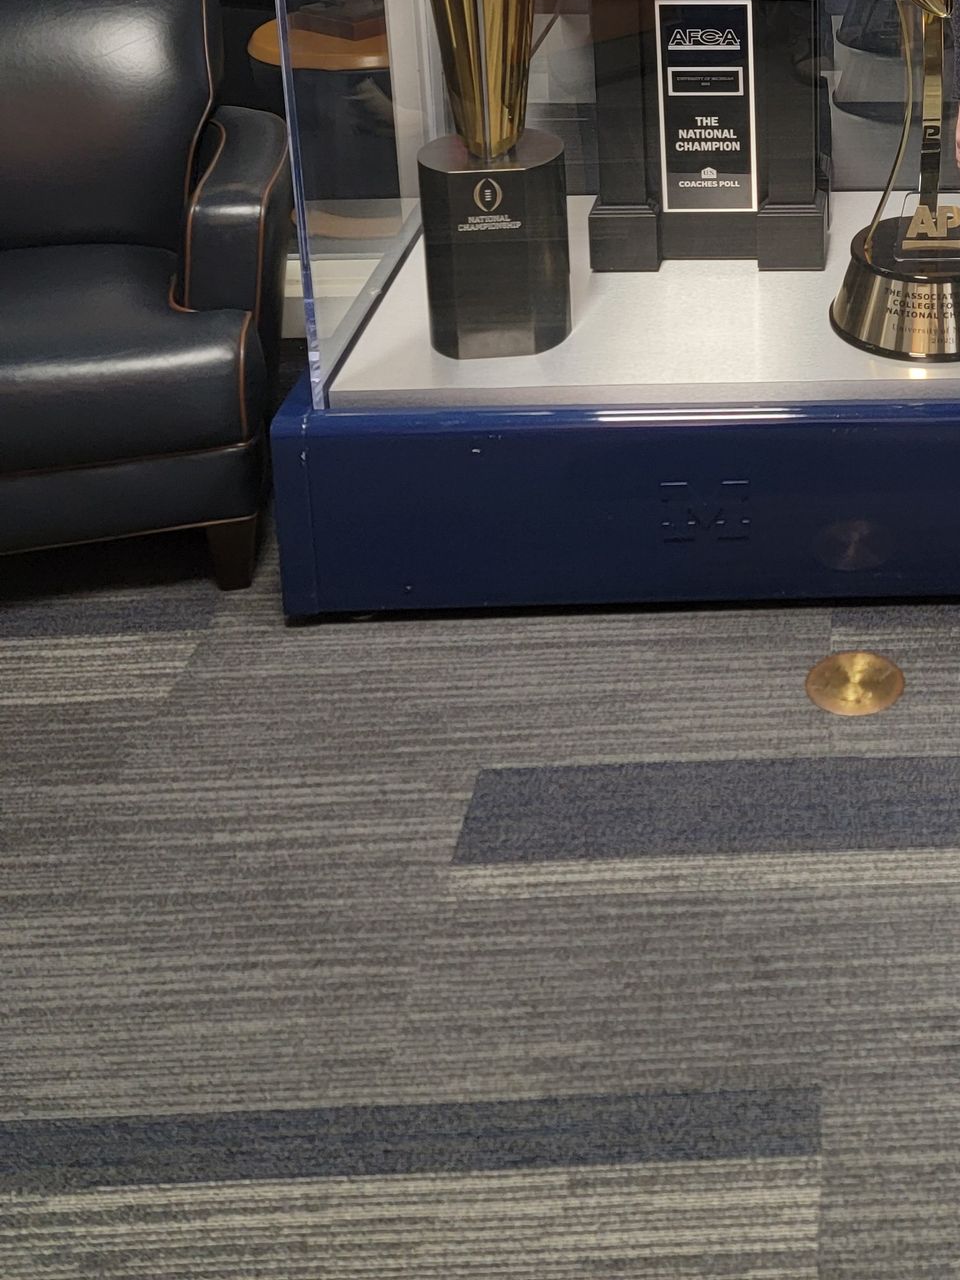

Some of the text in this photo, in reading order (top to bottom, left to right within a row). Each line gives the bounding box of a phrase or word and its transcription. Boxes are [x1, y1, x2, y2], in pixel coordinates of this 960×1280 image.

[668, 28, 740, 46] AFCA
[695, 116, 719, 126] THE
[678, 129, 737, 139] NATIONAL
[675, 141, 740, 152] CHAMPION
[678, 180, 740, 188] COACHES POLL
[467, 214, 511, 223] NATIONAL
[884, 287, 902, 297] THE
[893, 299, 937, 310] COLLEGE
[887, 307, 939, 320] NATIONAL
